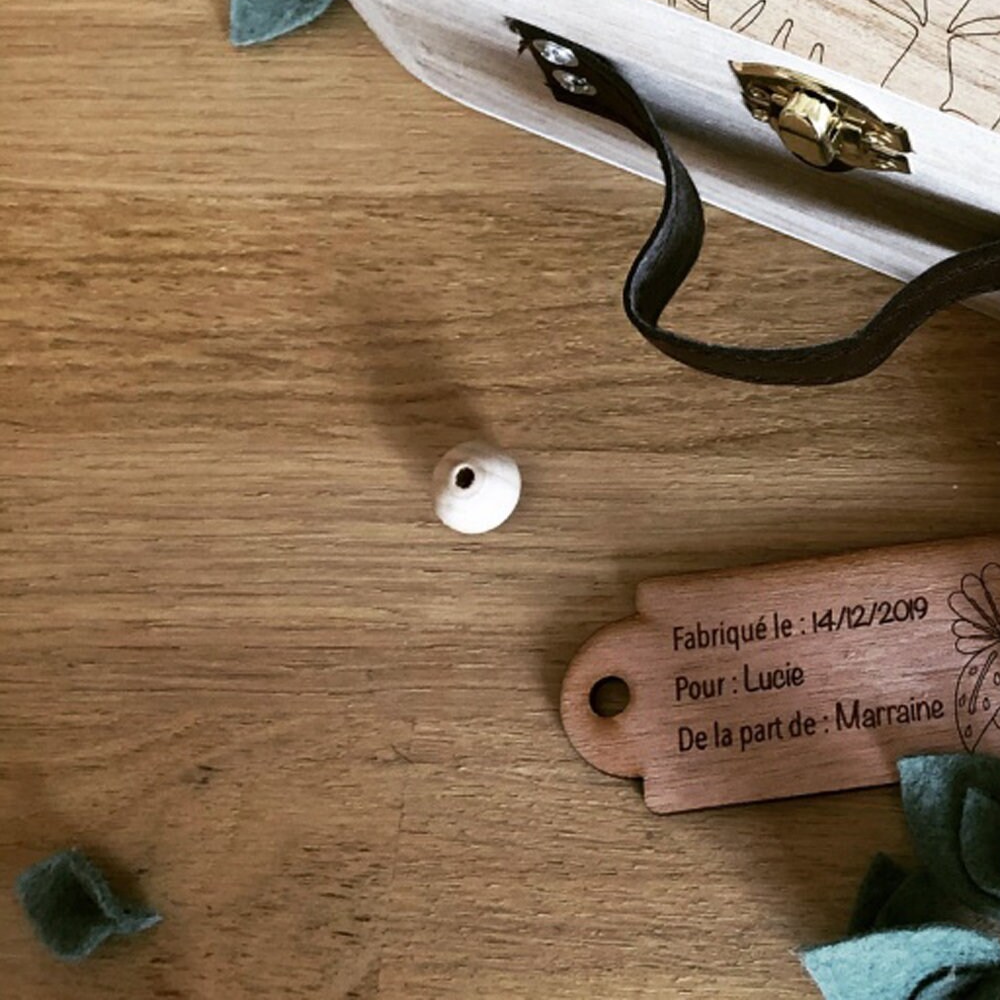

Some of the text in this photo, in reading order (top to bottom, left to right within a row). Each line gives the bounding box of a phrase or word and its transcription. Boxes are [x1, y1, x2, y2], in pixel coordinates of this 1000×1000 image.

[673, 615, 767, 651] Fabriqué
[812, 596, 929, 634] 14/12/2019
[743, 662, 805, 693] Lucie
[678, 726, 708, 752] De
[714, 721, 733, 749] la
[740, 716, 784, 752] part
[788, 711, 817, 739] de
[835, 697, 945, 732] Marraine
